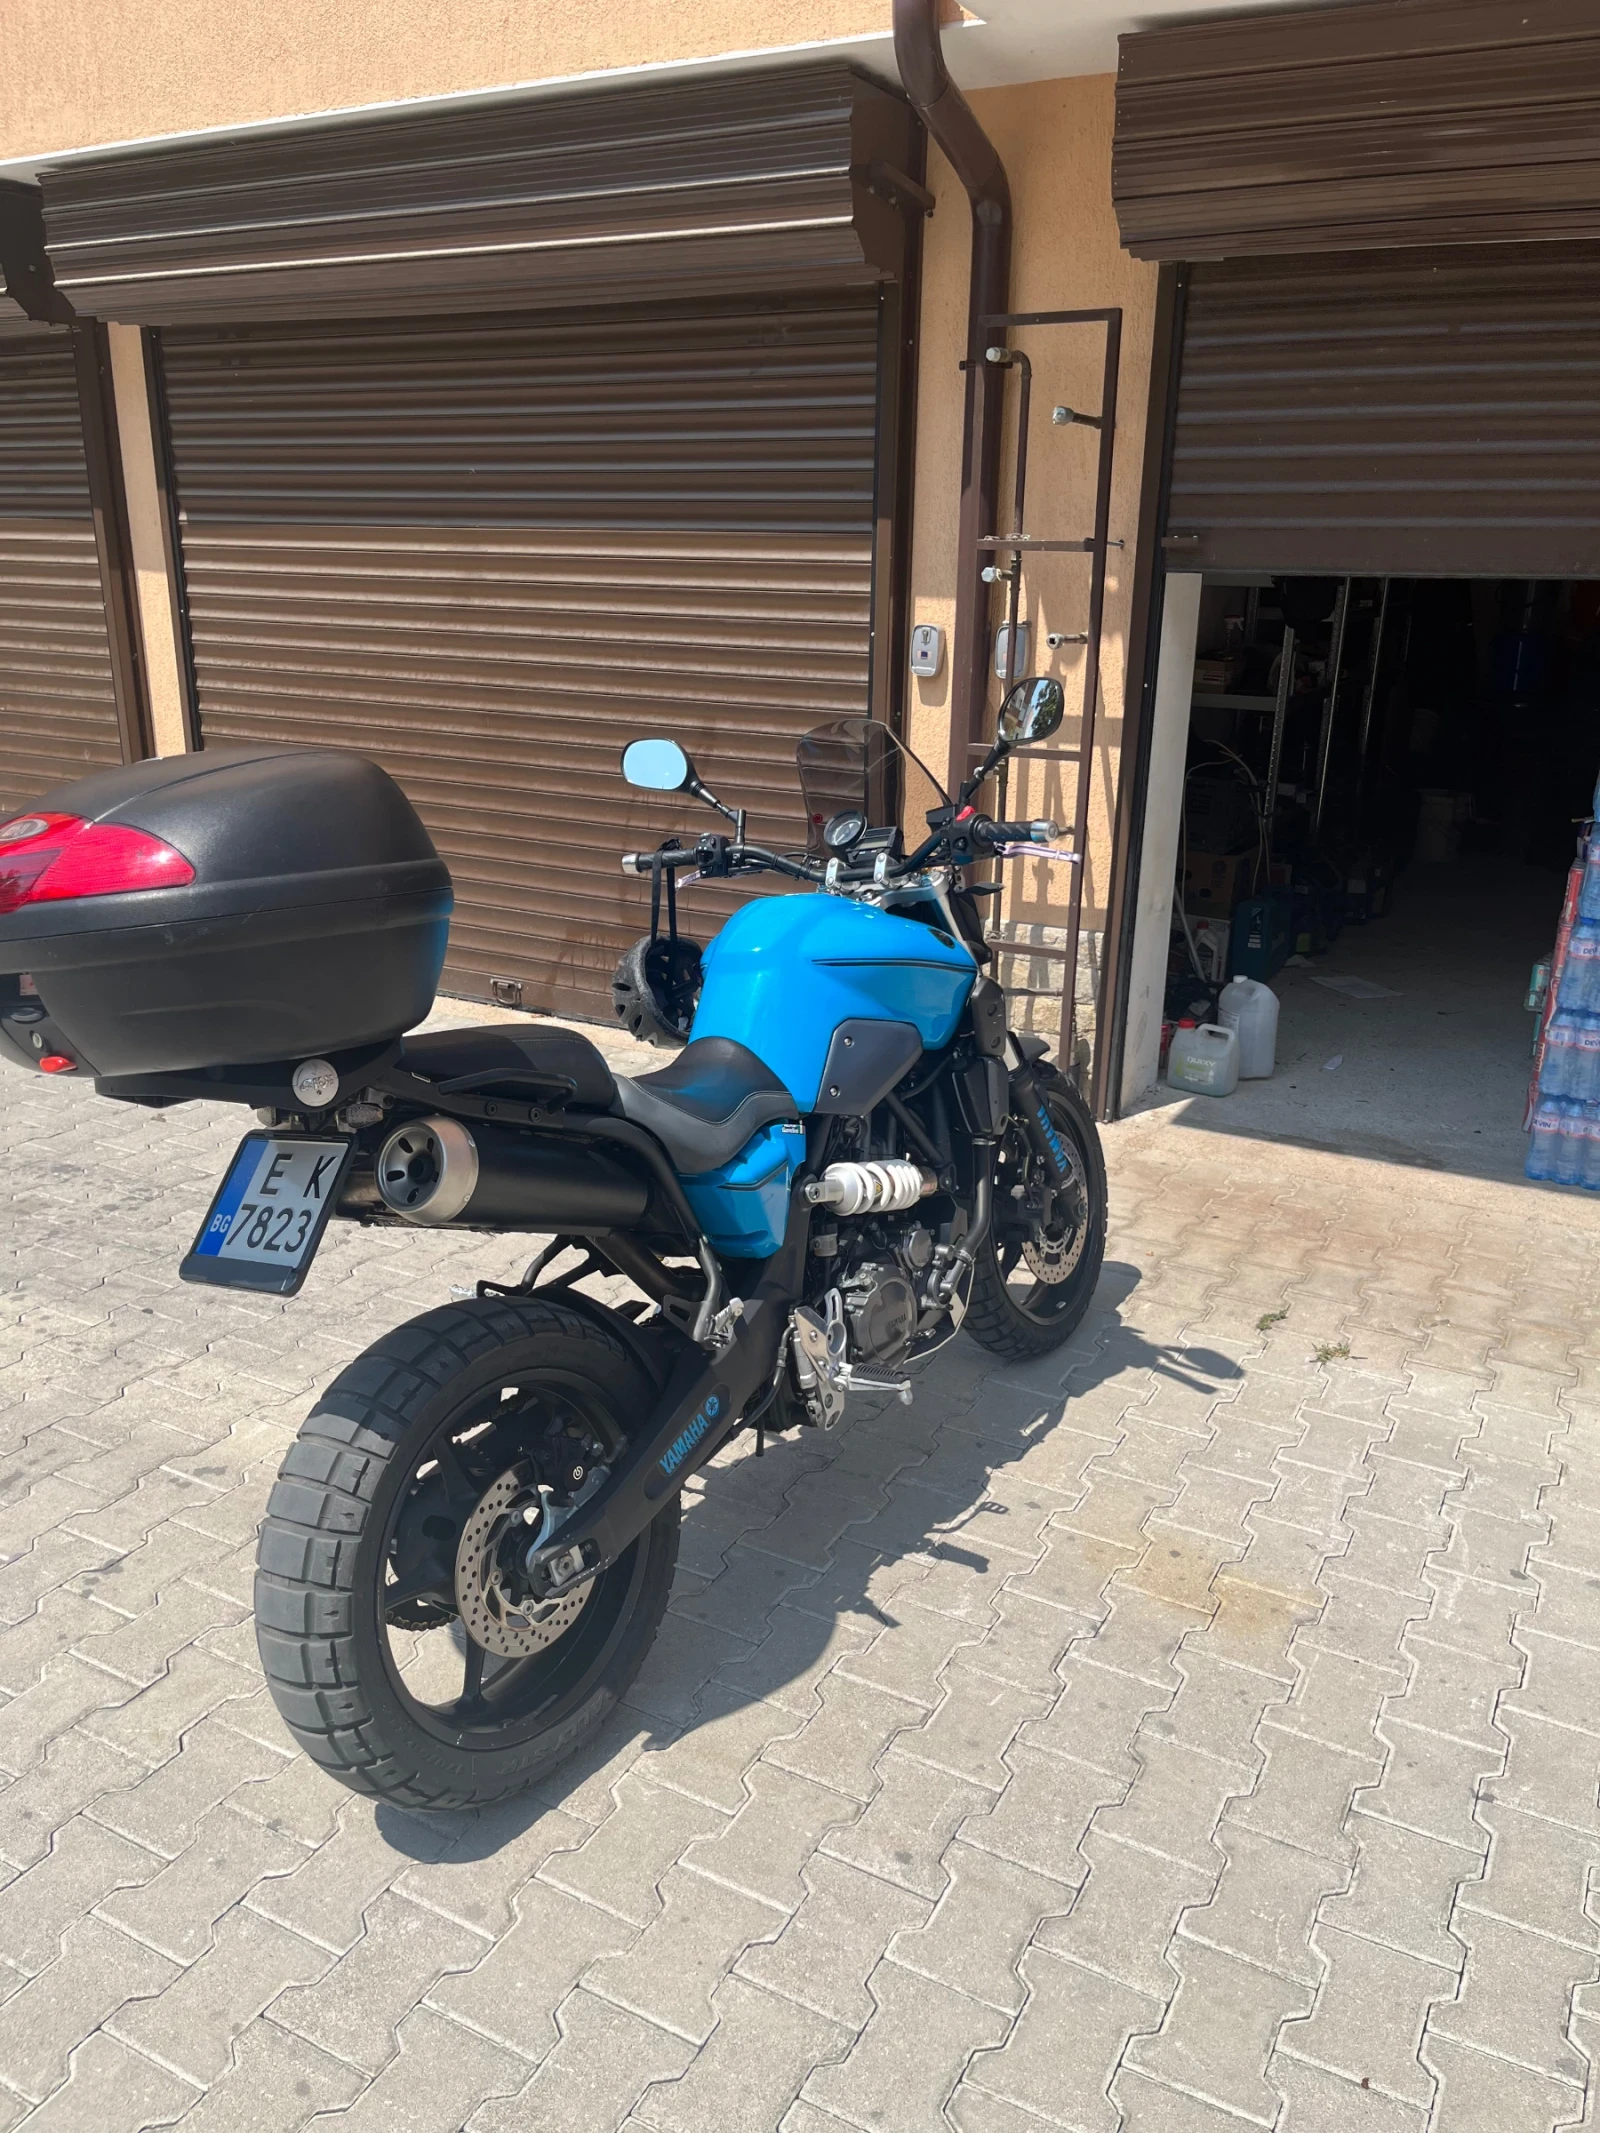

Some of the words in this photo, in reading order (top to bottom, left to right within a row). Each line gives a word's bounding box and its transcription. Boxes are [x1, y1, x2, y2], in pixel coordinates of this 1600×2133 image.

[1187, 1056, 1216, 1067] QUIXY
[259, 1153, 294, 1196] E
[302, 1155, 338, 1199] K
[209, 1213, 233, 1234] BG
[226, 1203, 312, 1253] 7823
[659, 1413, 709, 1475] YAMAHA
